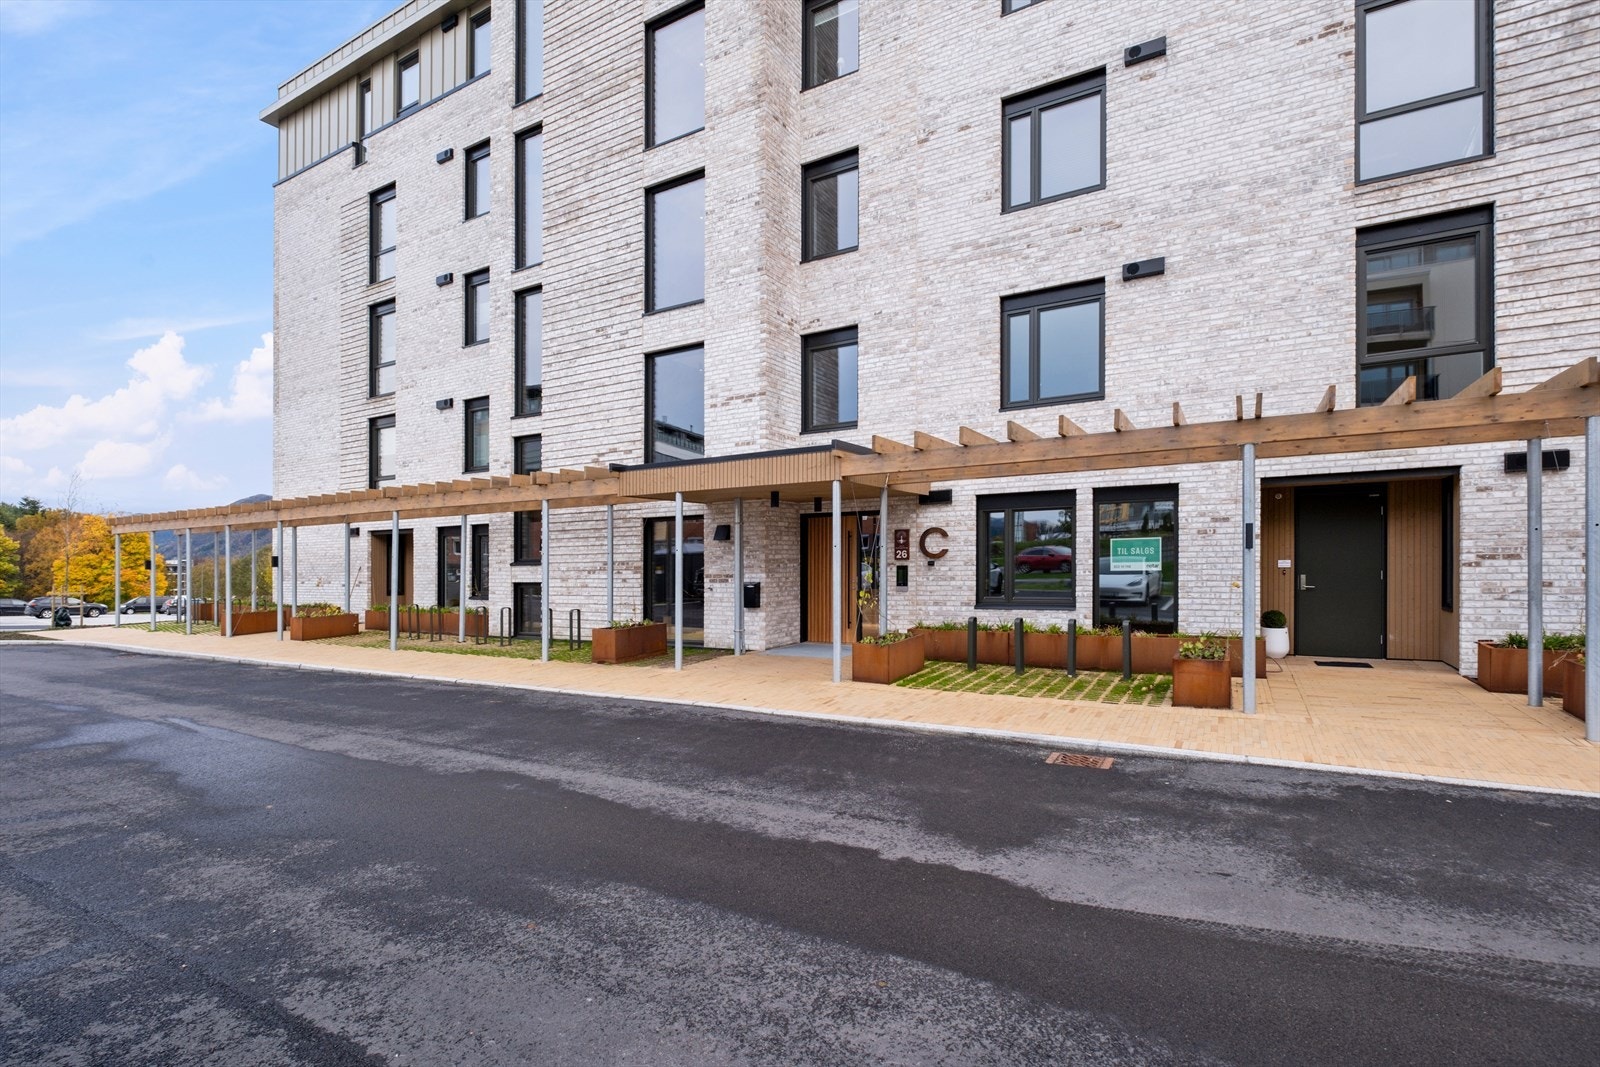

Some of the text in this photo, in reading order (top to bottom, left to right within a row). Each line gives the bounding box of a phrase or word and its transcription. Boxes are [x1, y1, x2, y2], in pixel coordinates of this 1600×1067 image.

[919, 527, 949, 559] C
[896, 550, 908, 558] 26
[1130, 546, 1154, 555] SALGS
